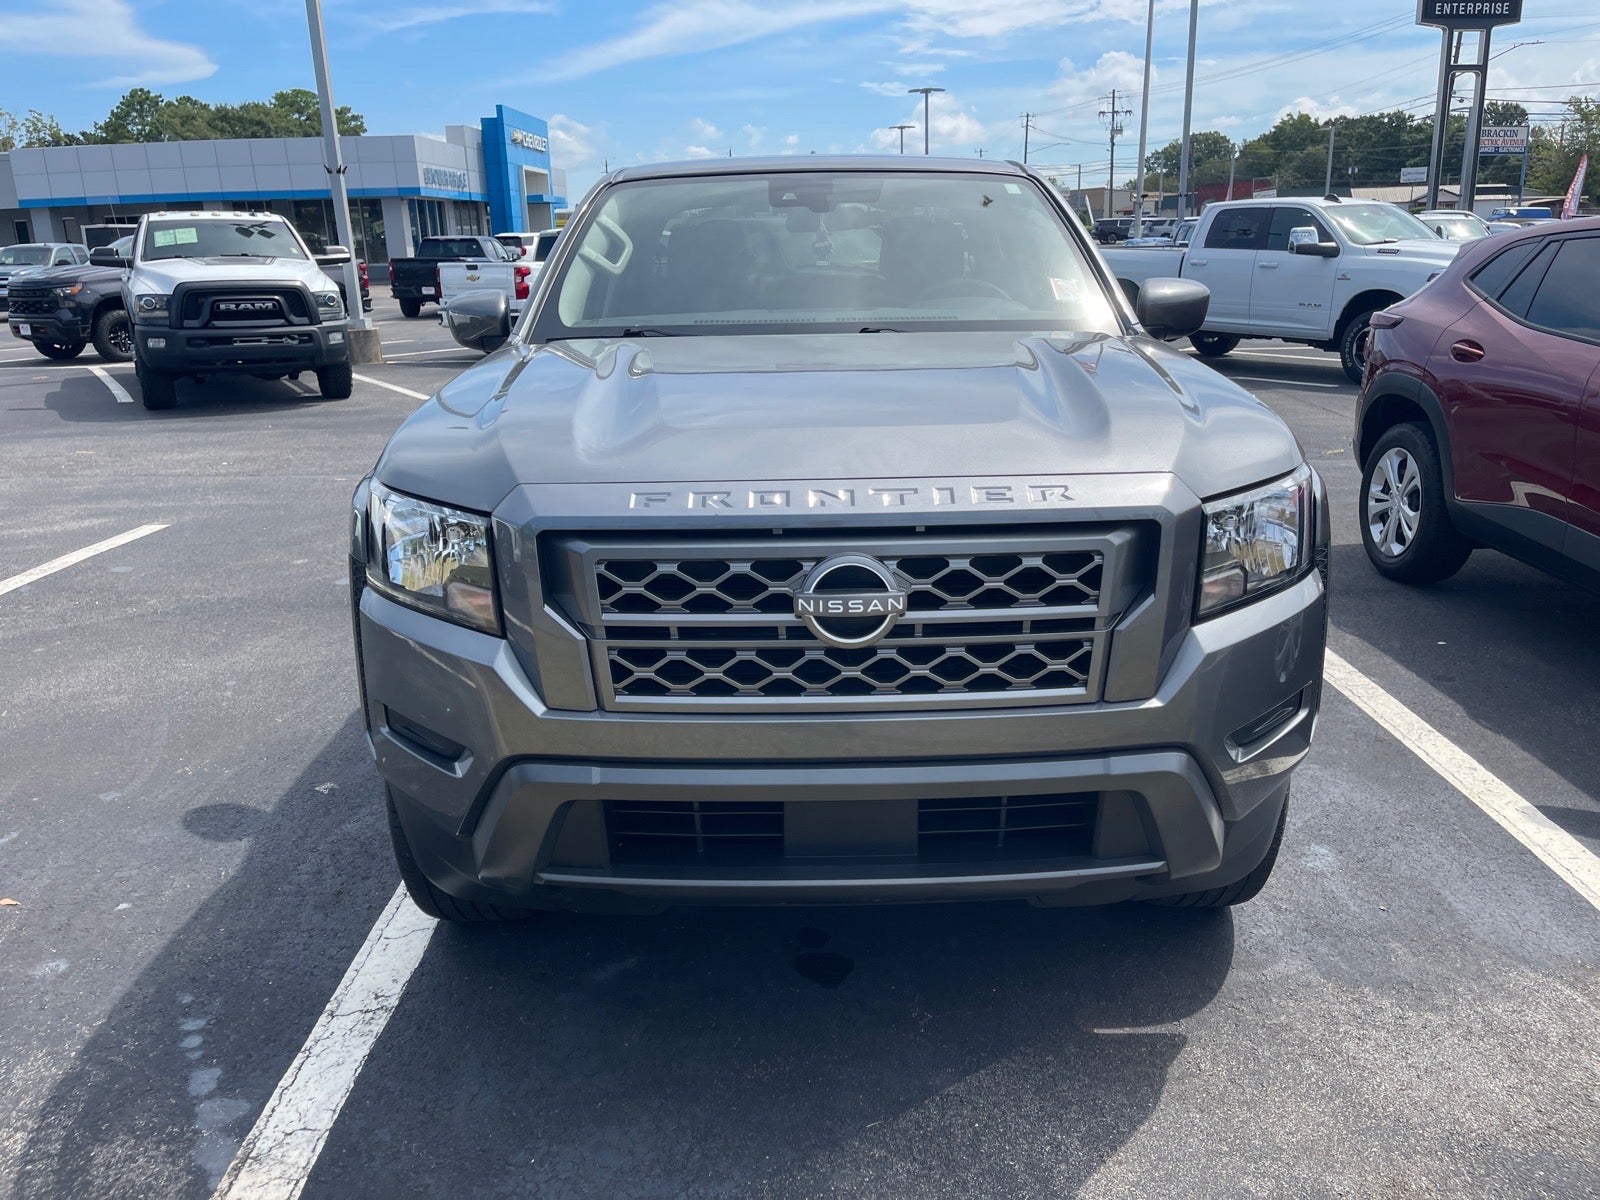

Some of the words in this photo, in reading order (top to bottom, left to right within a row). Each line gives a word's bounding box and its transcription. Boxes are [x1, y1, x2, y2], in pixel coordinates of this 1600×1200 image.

[1435, 3, 1510, 15] ENTERPRISE
[1481, 129, 1518, 137] BRACKIN
[522, 131, 548, 152] CHEVROLET
[220, 303, 273, 311] RAM
[629, 483, 1076, 509] FRONTIER
[798, 597, 904, 613] NISSAN
